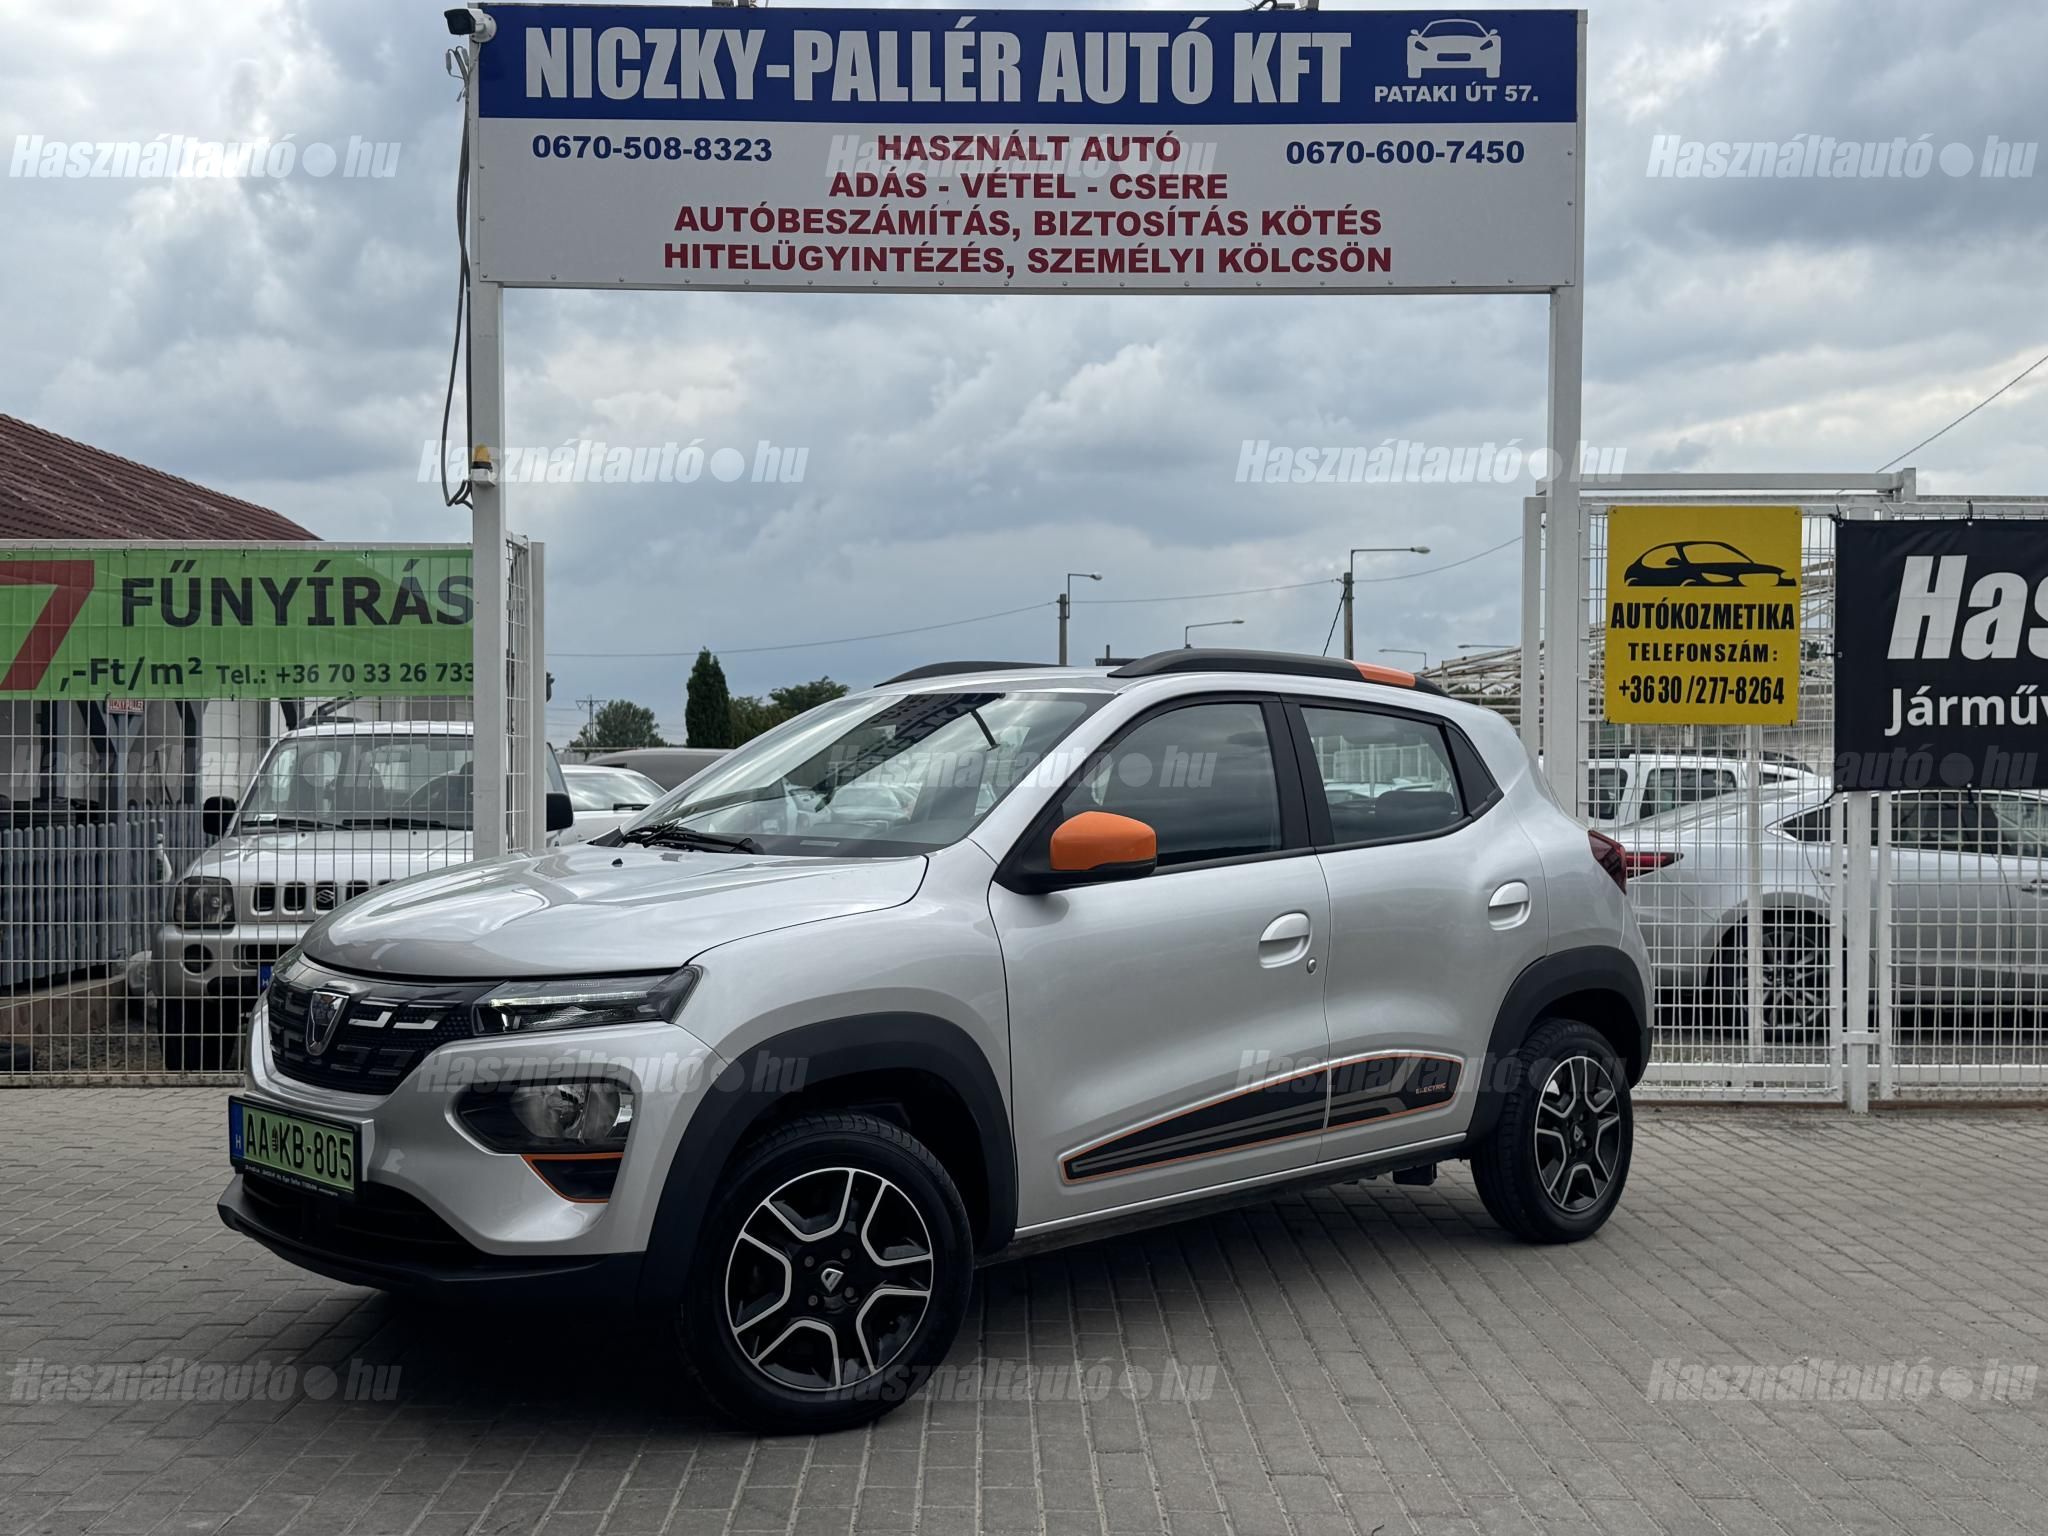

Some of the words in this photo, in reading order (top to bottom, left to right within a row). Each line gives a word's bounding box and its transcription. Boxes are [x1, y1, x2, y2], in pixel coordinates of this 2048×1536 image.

[525, 16, 1022, 102] NICZKY-PALLÉR
[1038, 17, 1214, 105] AUTÓ
[1233, 32, 1352, 104] KFT
[1374, 84, 1457, 103] PATAKI
[1465, 80, 1497, 103] ÚT
[1505, 84, 1539, 103] 57.
[532, 134, 773, 162] 0670-508-8323
[877, 129, 1069, 161] HASZNÁLT
[1081, 130, 1181, 162] AUTÓ
[1286, 140, 1525, 165] 0670-600-7450
[829, 167, 927, 198] ADÁS
[960, 167, 1076, 199] VÉTEL
[1110, 173, 1228, 199] CSERE
[674, 202, 1020, 241] AUTÓBESZÁMÍTÁS,
[1034, 204, 1249, 237] BIZTOSÍTÁS
[1261, 204, 1382, 236] KÖTÉS
[664, 239, 1015, 279] HITELÜGYINTÉZÉS,
[1027, 242, 1204, 274] SZEMÉLYI
[1218, 242, 1392, 273] KÖLCSÖN
[122, 558, 473, 627] FŰNYÍRÁS
[1610, 597, 1795, 630] AUTÓKOZMETIKA
[216, 664, 267, 685] Tel.:
[276, 663, 320, 684] +36
[328, 663, 356, 684] 70
[363, 662, 391, 683] 33
[400, 662, 427, 683] 26
[235, 1134, 242, 1149] H
